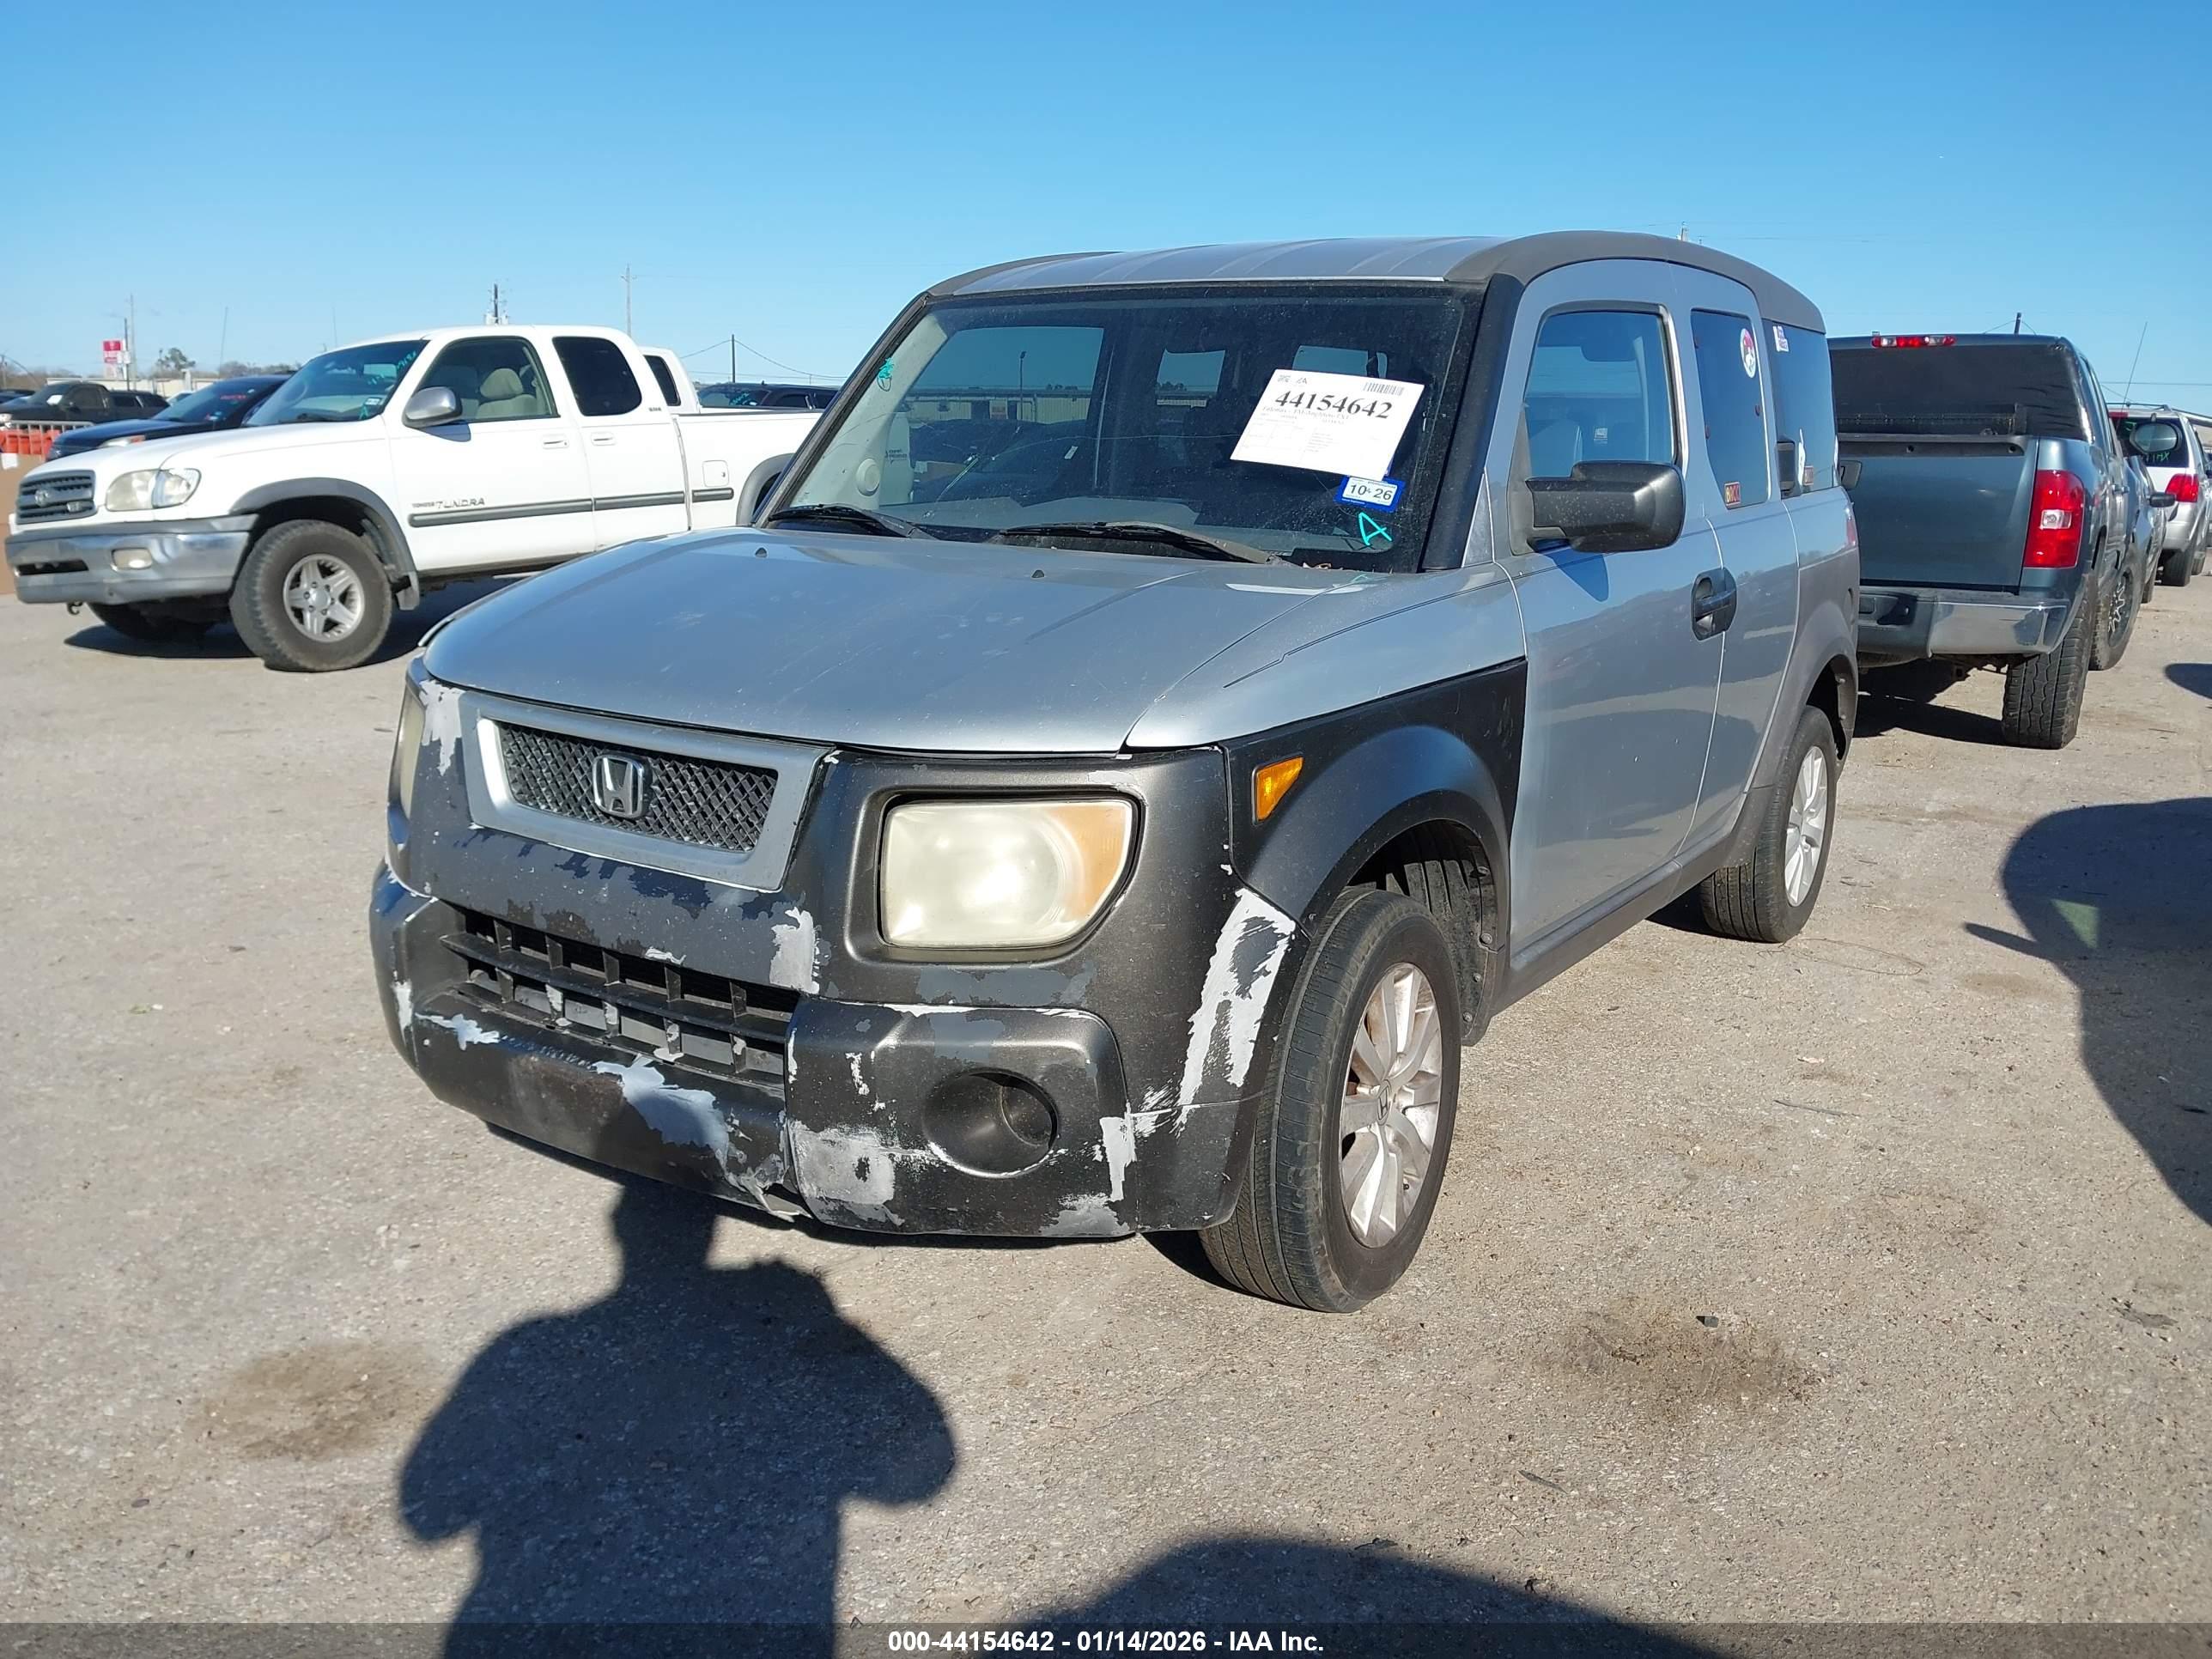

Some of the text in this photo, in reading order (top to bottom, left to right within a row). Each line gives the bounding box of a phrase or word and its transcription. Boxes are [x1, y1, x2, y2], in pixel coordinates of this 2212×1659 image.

[1275, 391, 1393, 419] 44154642
[1351, 484, 1367, 495] 10
[1374, 488, 1393, 501] 26
[435, 497, 486, 509] TUNDRA
